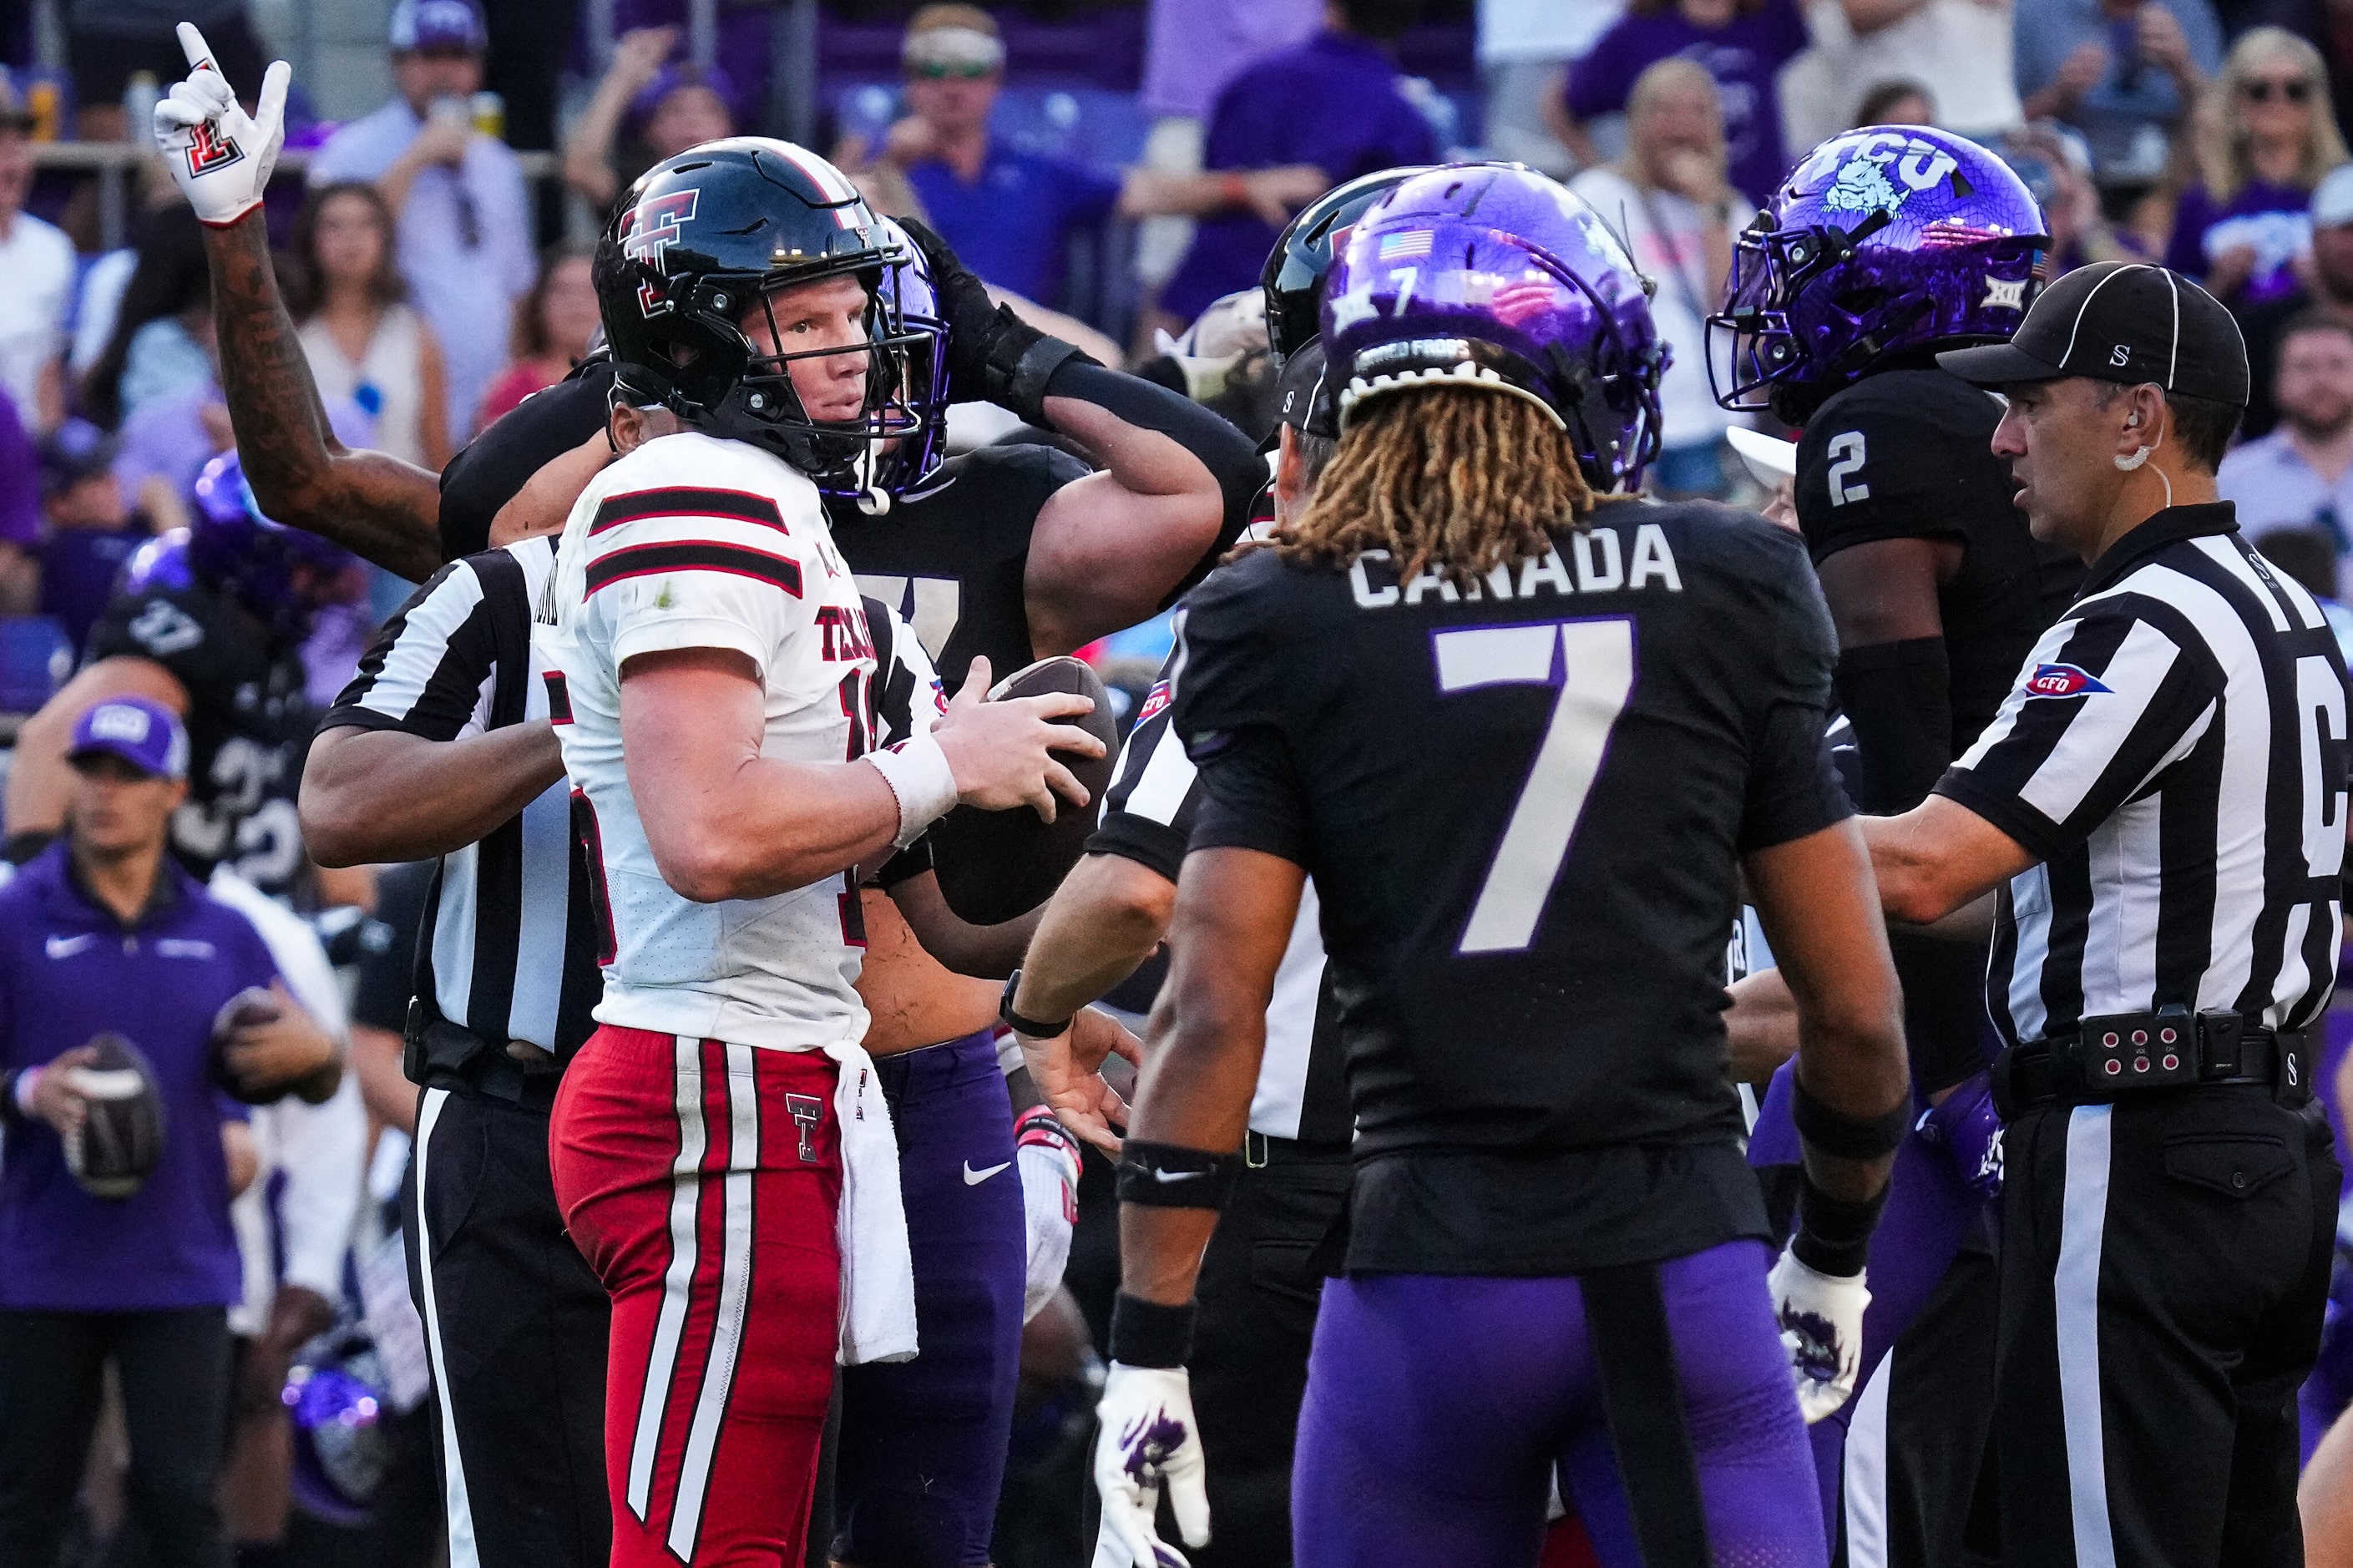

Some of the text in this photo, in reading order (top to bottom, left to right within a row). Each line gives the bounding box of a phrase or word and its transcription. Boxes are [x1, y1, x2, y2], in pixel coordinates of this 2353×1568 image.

[1810, 132, 1958, 192] TCU
[1389, 266, 1418, 318] 7
[1827, 430, 1870, 508] 2
[1141, 695, 1166, 713] CFO
[2037, 677, 2070, 692] CFO
[1429, 614, 1640, 957] 7
[2296, 655, 2349, 879] C
